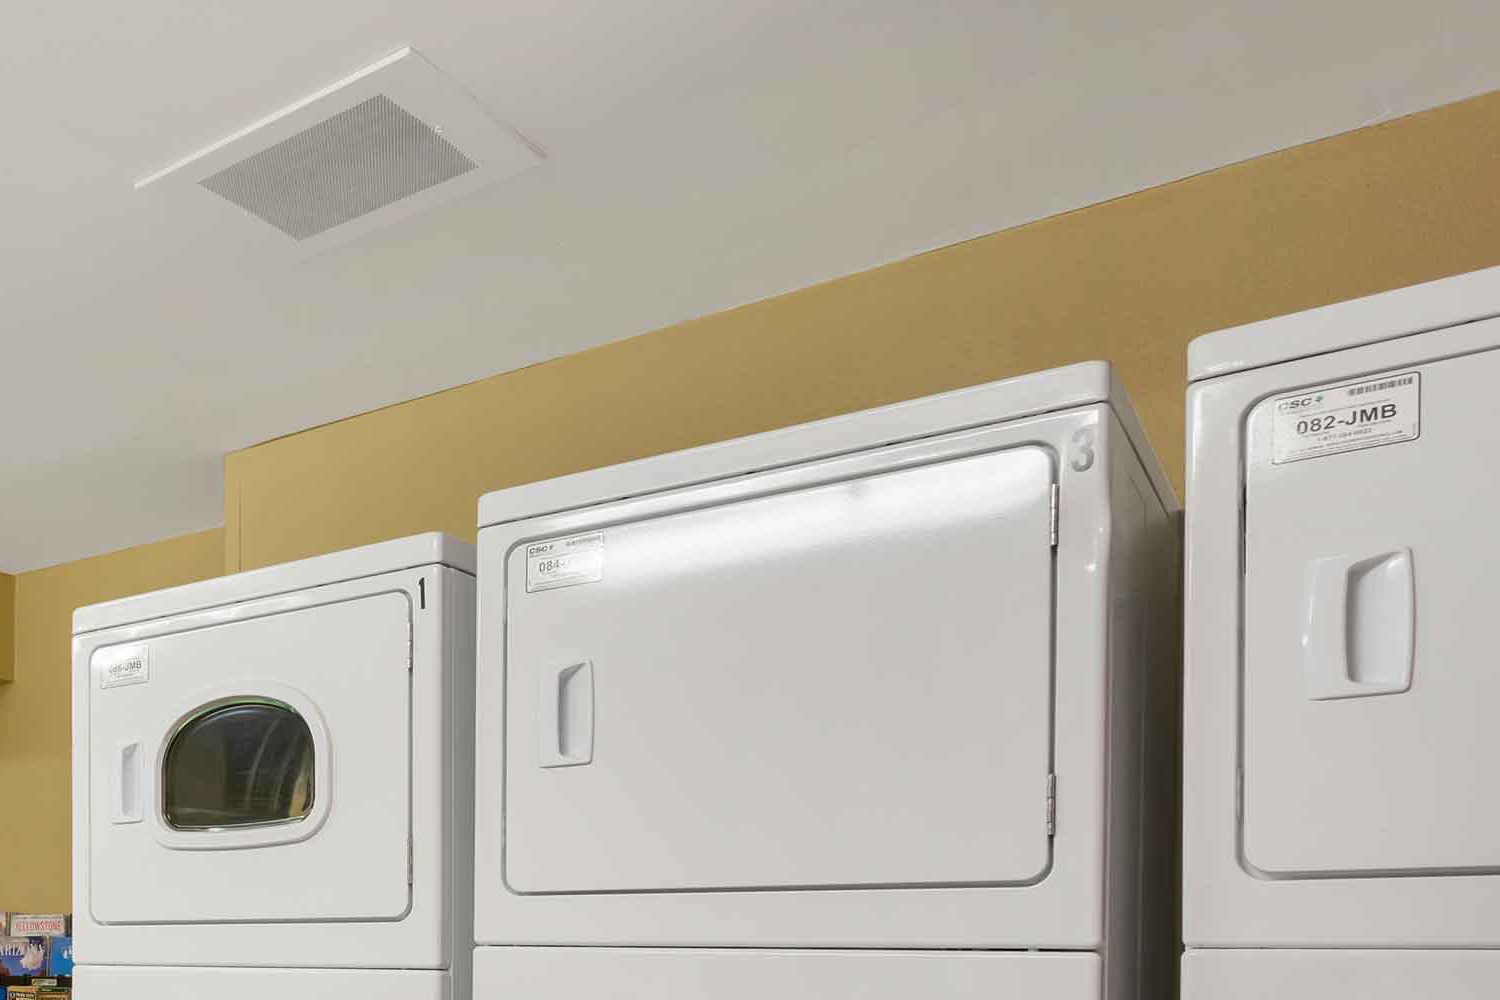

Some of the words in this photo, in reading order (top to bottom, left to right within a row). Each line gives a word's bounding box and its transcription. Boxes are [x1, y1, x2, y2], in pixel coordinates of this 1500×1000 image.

[1278, 397, 1312, 412] CSC
[1296, 403, 1397, 435] 082-JMB
[1071, 427, 1094, 472] 3
[418, 577, 426, 610] 1
